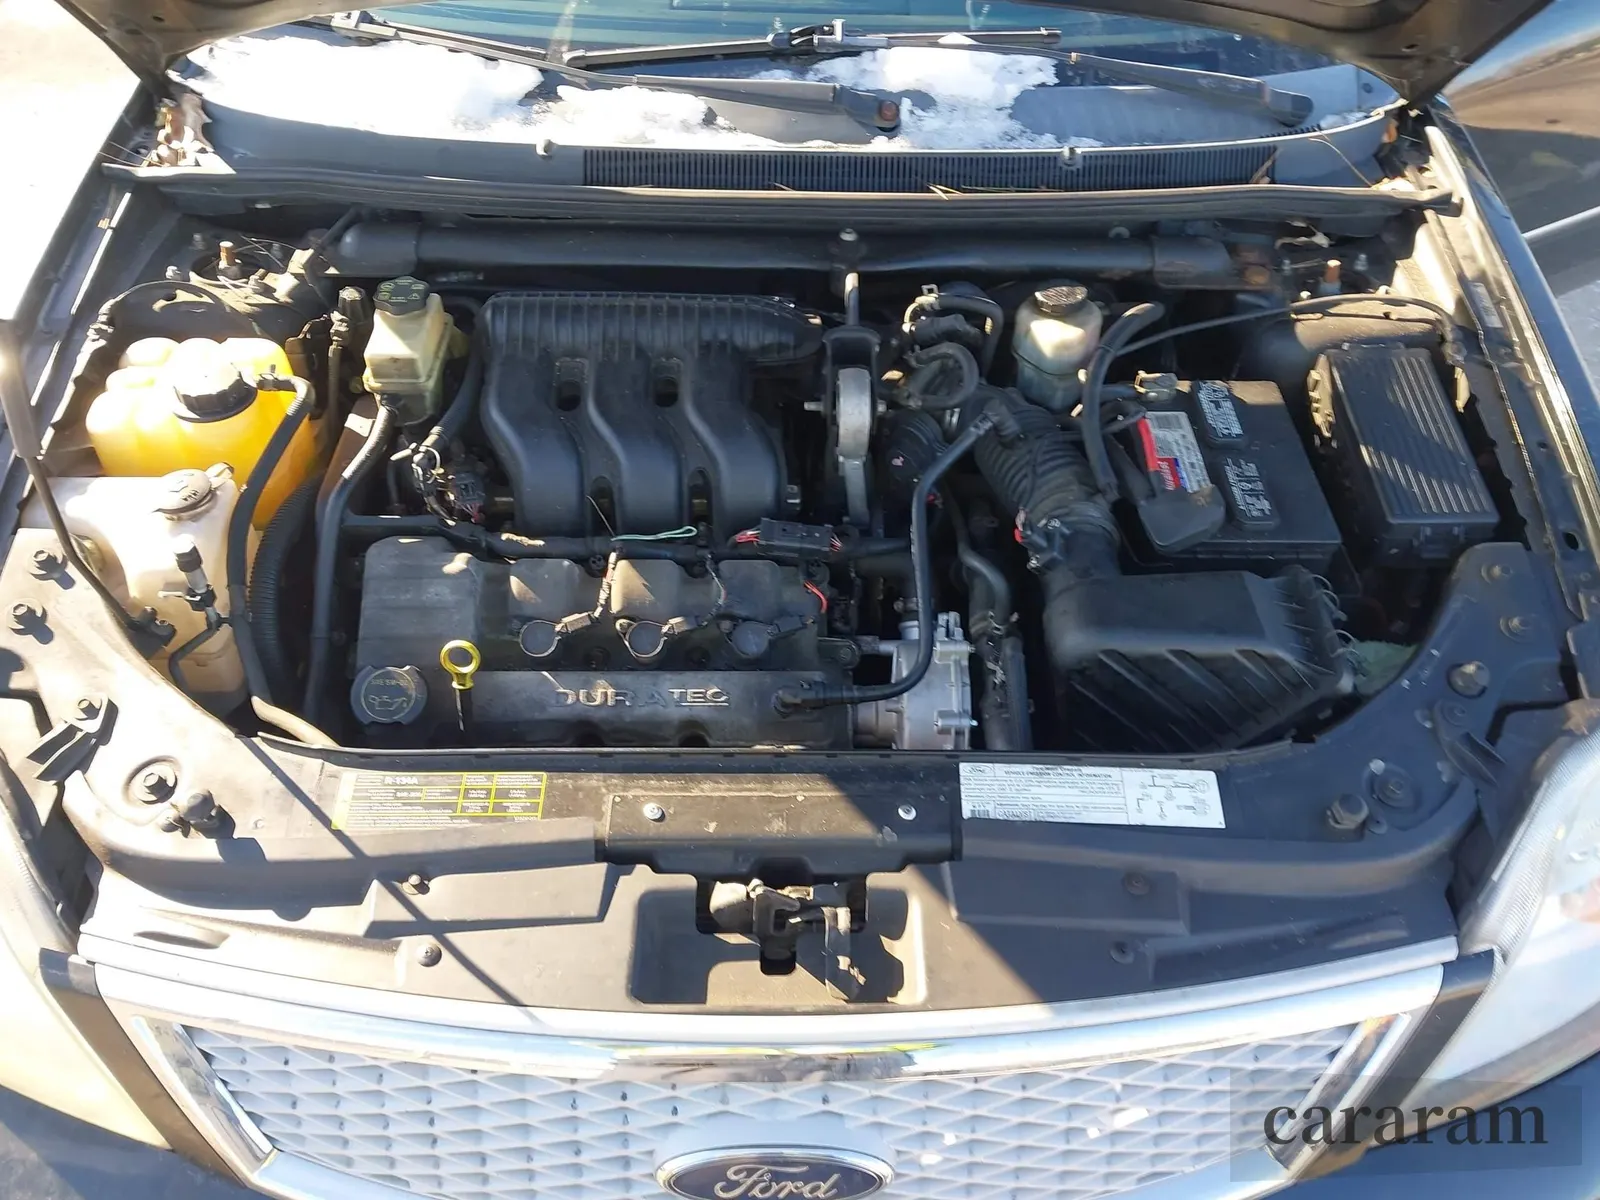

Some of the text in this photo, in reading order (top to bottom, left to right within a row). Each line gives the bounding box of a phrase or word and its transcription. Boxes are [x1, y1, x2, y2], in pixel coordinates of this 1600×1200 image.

[1157, 461, 1175, 491] uralast
[553, 687, 731, 708] DURATEC
[713, 1163, 842, 1199] Ford
